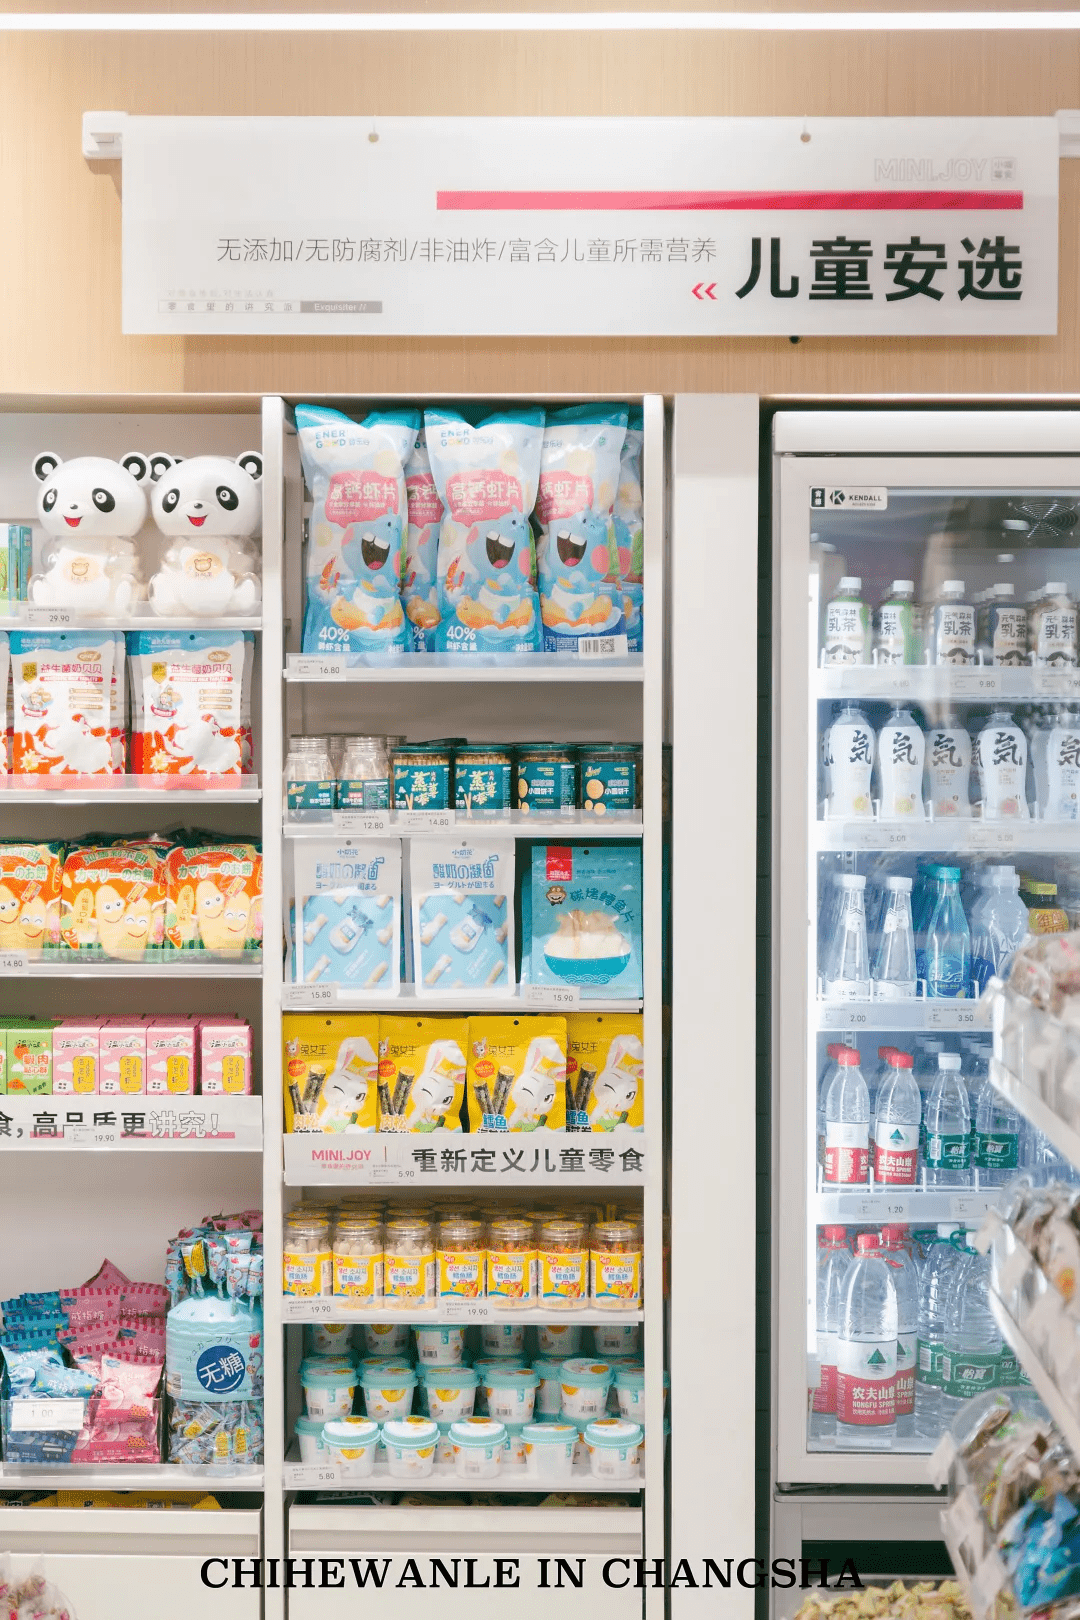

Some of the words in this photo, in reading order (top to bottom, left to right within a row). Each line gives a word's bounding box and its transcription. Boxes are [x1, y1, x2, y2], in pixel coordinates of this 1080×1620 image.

[217, 237, 717, 263] 无添加/无防腐剂/非油炸/富含儿童所需营养
[735, 235, 1023, 302] 儿童安选
[314, 303, 357, 312] Exquisiter
[451, 480, 519, 501] 高钙虾片
[829, 618, 857, 632] 乳茶
[943, 621, 971, 635] 乳茶
[1001, 623, 1026, 638] 乳茶
[319, 626, 350, 641] 40%
[446, 625, 476, 641] 40%
[1045, 624, 1075, 639] 乳茶
[41, 664, 102, 674] 益生菌奶贝贝
[170, 663, 232, 674] 益生菌奶贝贝
[979, 680, 995, 688] 9.80
[429, 818, 449, 826] 14.80
[75, 867, 154, 883] カマリーのお餅
[177, 861, 253, 879] カマリーのお餅
[433, 881, 495, 889] ヨーグルトが固まる
[2, 960, 23, 968] 14.80
[311, 990, 331, 998] 15.80
[553, 994, 573, 1002] 15.90
[390, 1045, 417, 1056] 兔女王
[571, 1042, 597, 1053] 兔女王
[483, 1113, 508, 1129] 鳕鱼
[411, 1148, 645, 1173] 重新定义儿童零食
[879, 1156, 913, 1166] 农夫山泉
[296, 1265, 313, 1273] 소시지
[349, 1267, 367, 1275] 소시지
[505, 1265, 522, 1273] 소시지
[311, 1305, 331, 1313] 19.90
[467, 1308, 488, 1316] 19.90
[71, 1309, 104, 1321] 戒指糖
[198, 1351, 246, 1388] 无糖
[852, 1400, 877, 1408] NONGFU
[318, 1472, 335, 1480] 5.80
